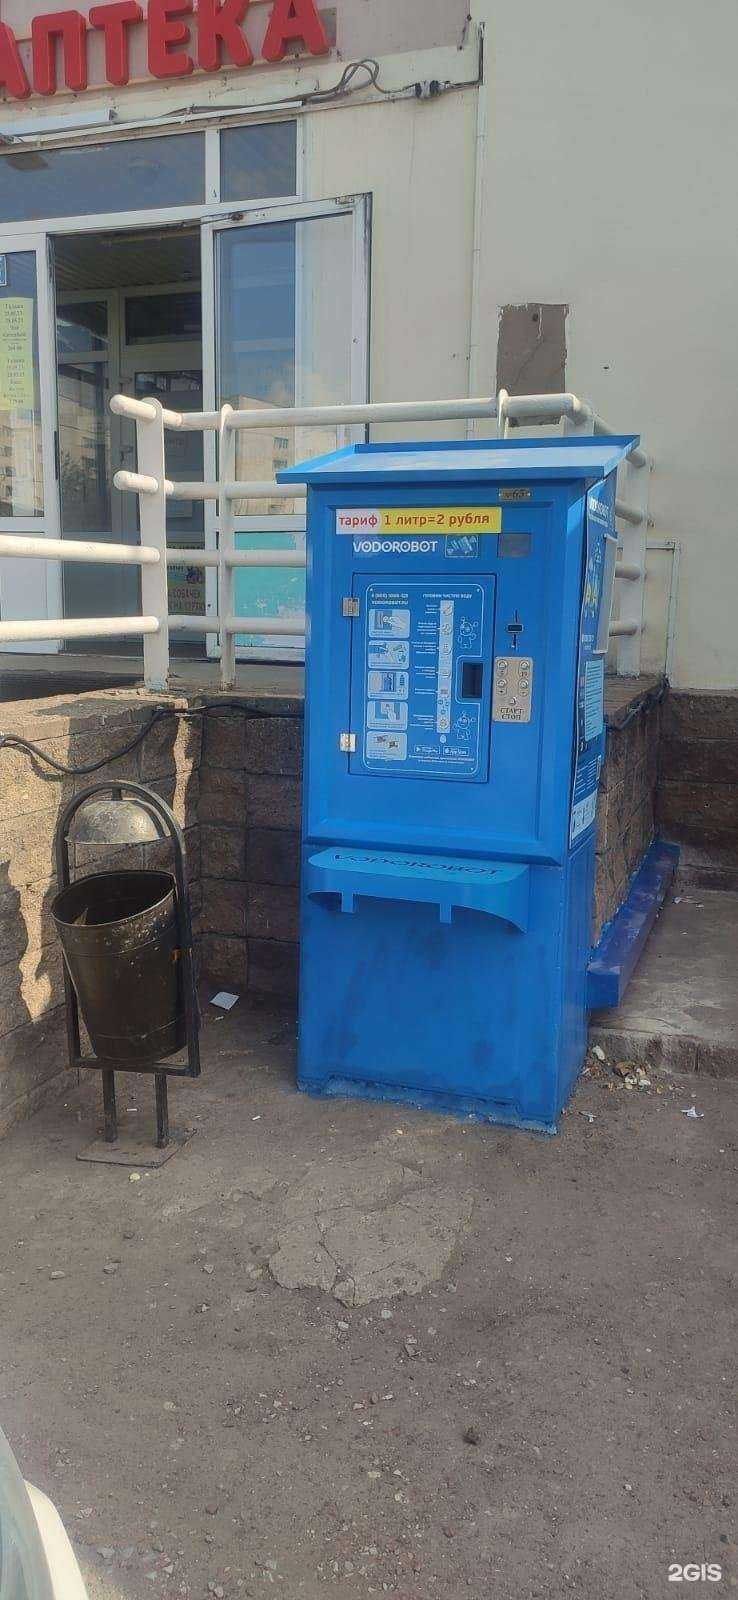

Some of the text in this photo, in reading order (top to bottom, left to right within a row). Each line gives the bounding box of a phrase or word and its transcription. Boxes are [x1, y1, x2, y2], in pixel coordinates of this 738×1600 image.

[338, 513, 490, 528] тариф 1 литр=2 рубля
[352, 540, 438, 554] VODOROBOT
[334, 854, 502, 876] VODOROBOT
